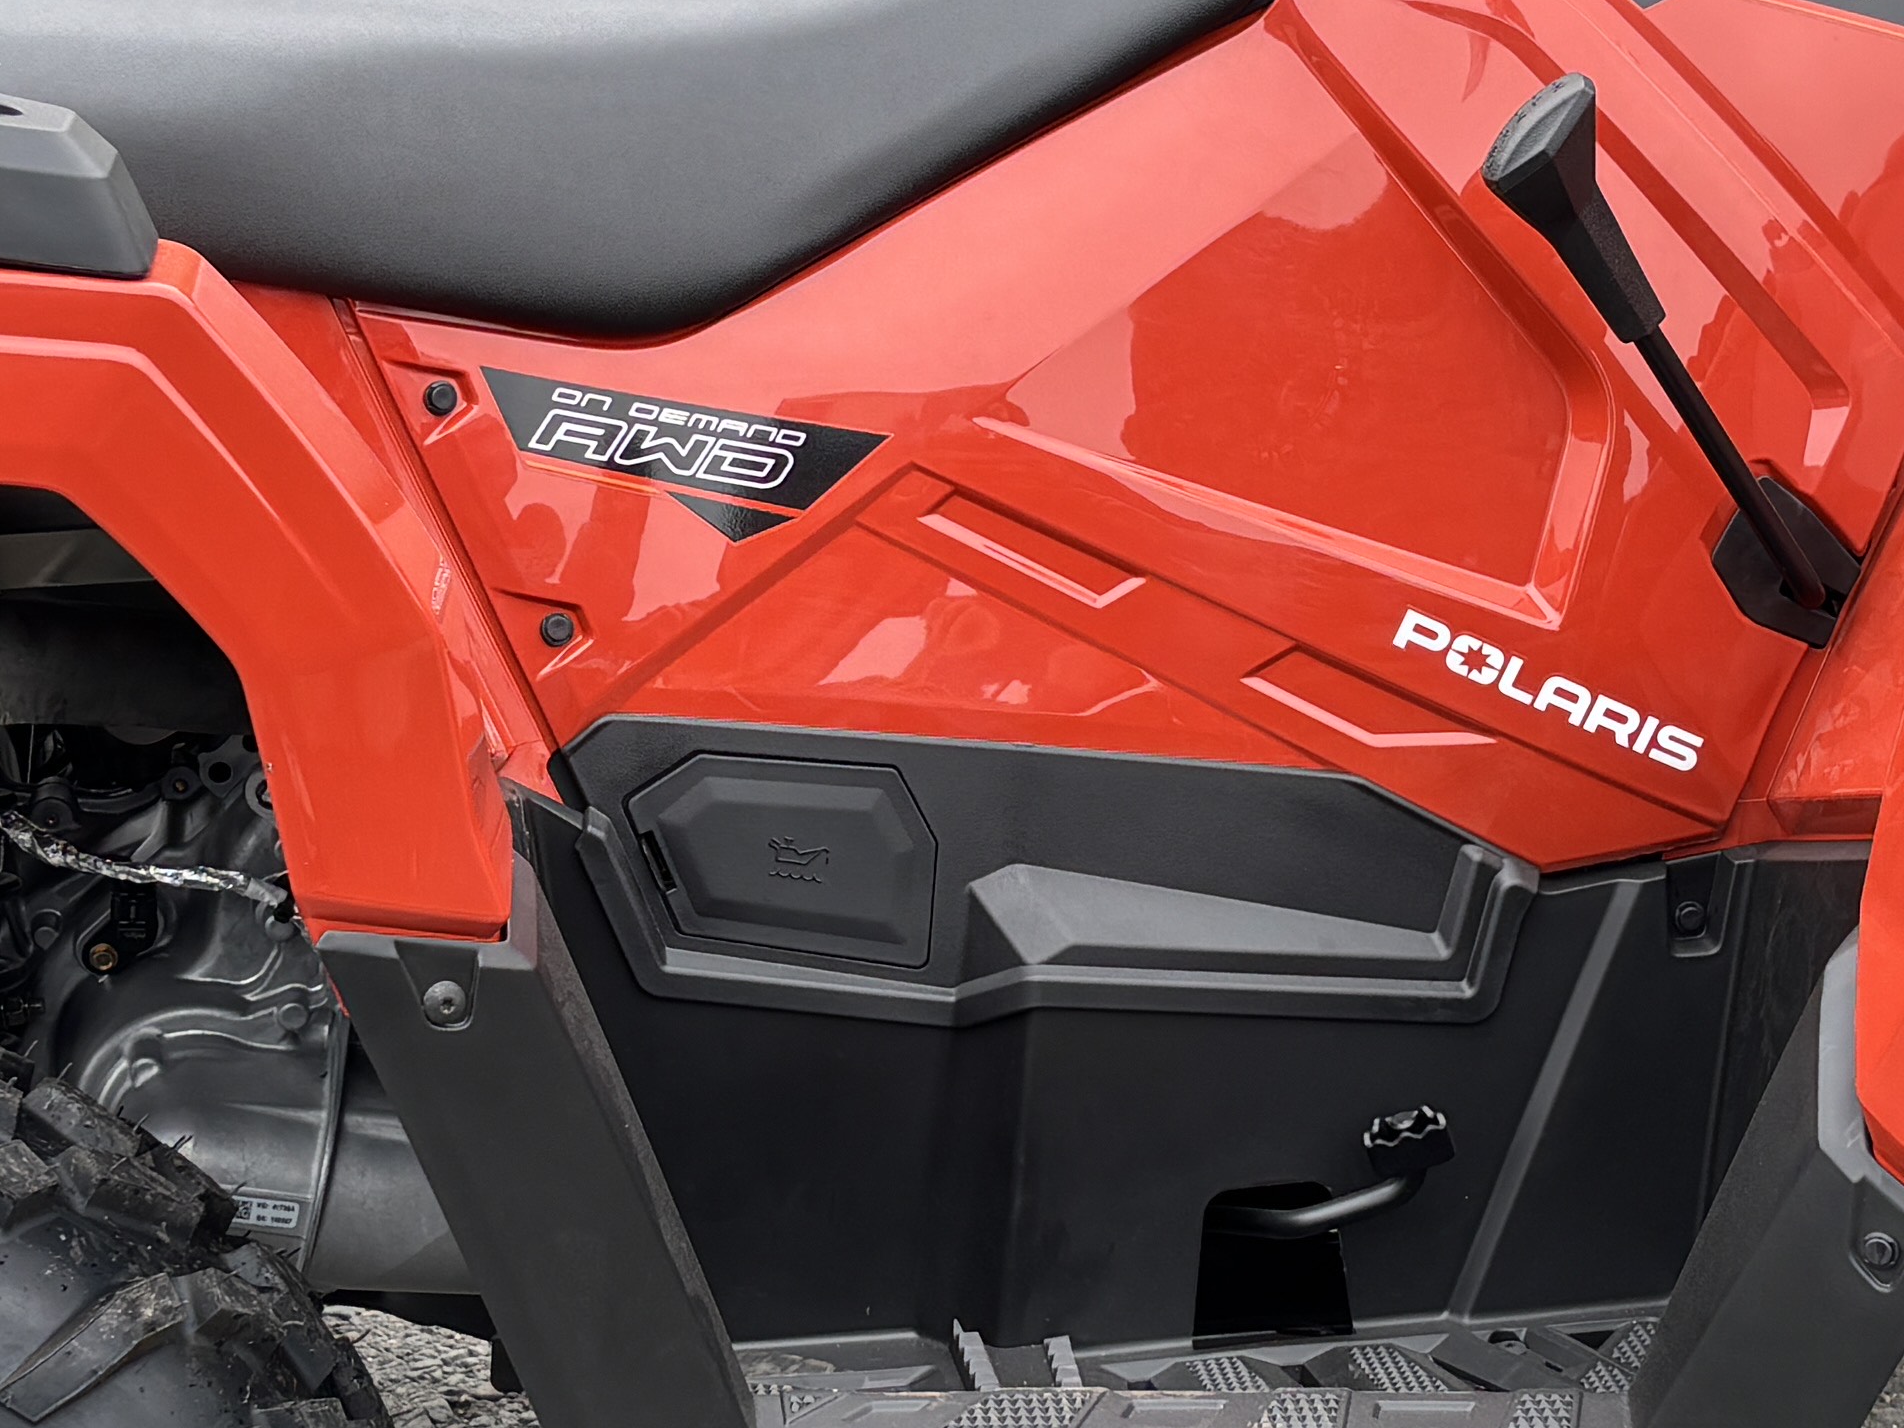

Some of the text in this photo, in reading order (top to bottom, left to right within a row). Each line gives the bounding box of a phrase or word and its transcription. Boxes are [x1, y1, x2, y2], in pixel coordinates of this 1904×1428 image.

[528, 408, 795, 490] AWD
[551, 387, 807, 447] ON DEMAND
[1392, 608, 1704, 772] POLARIS
